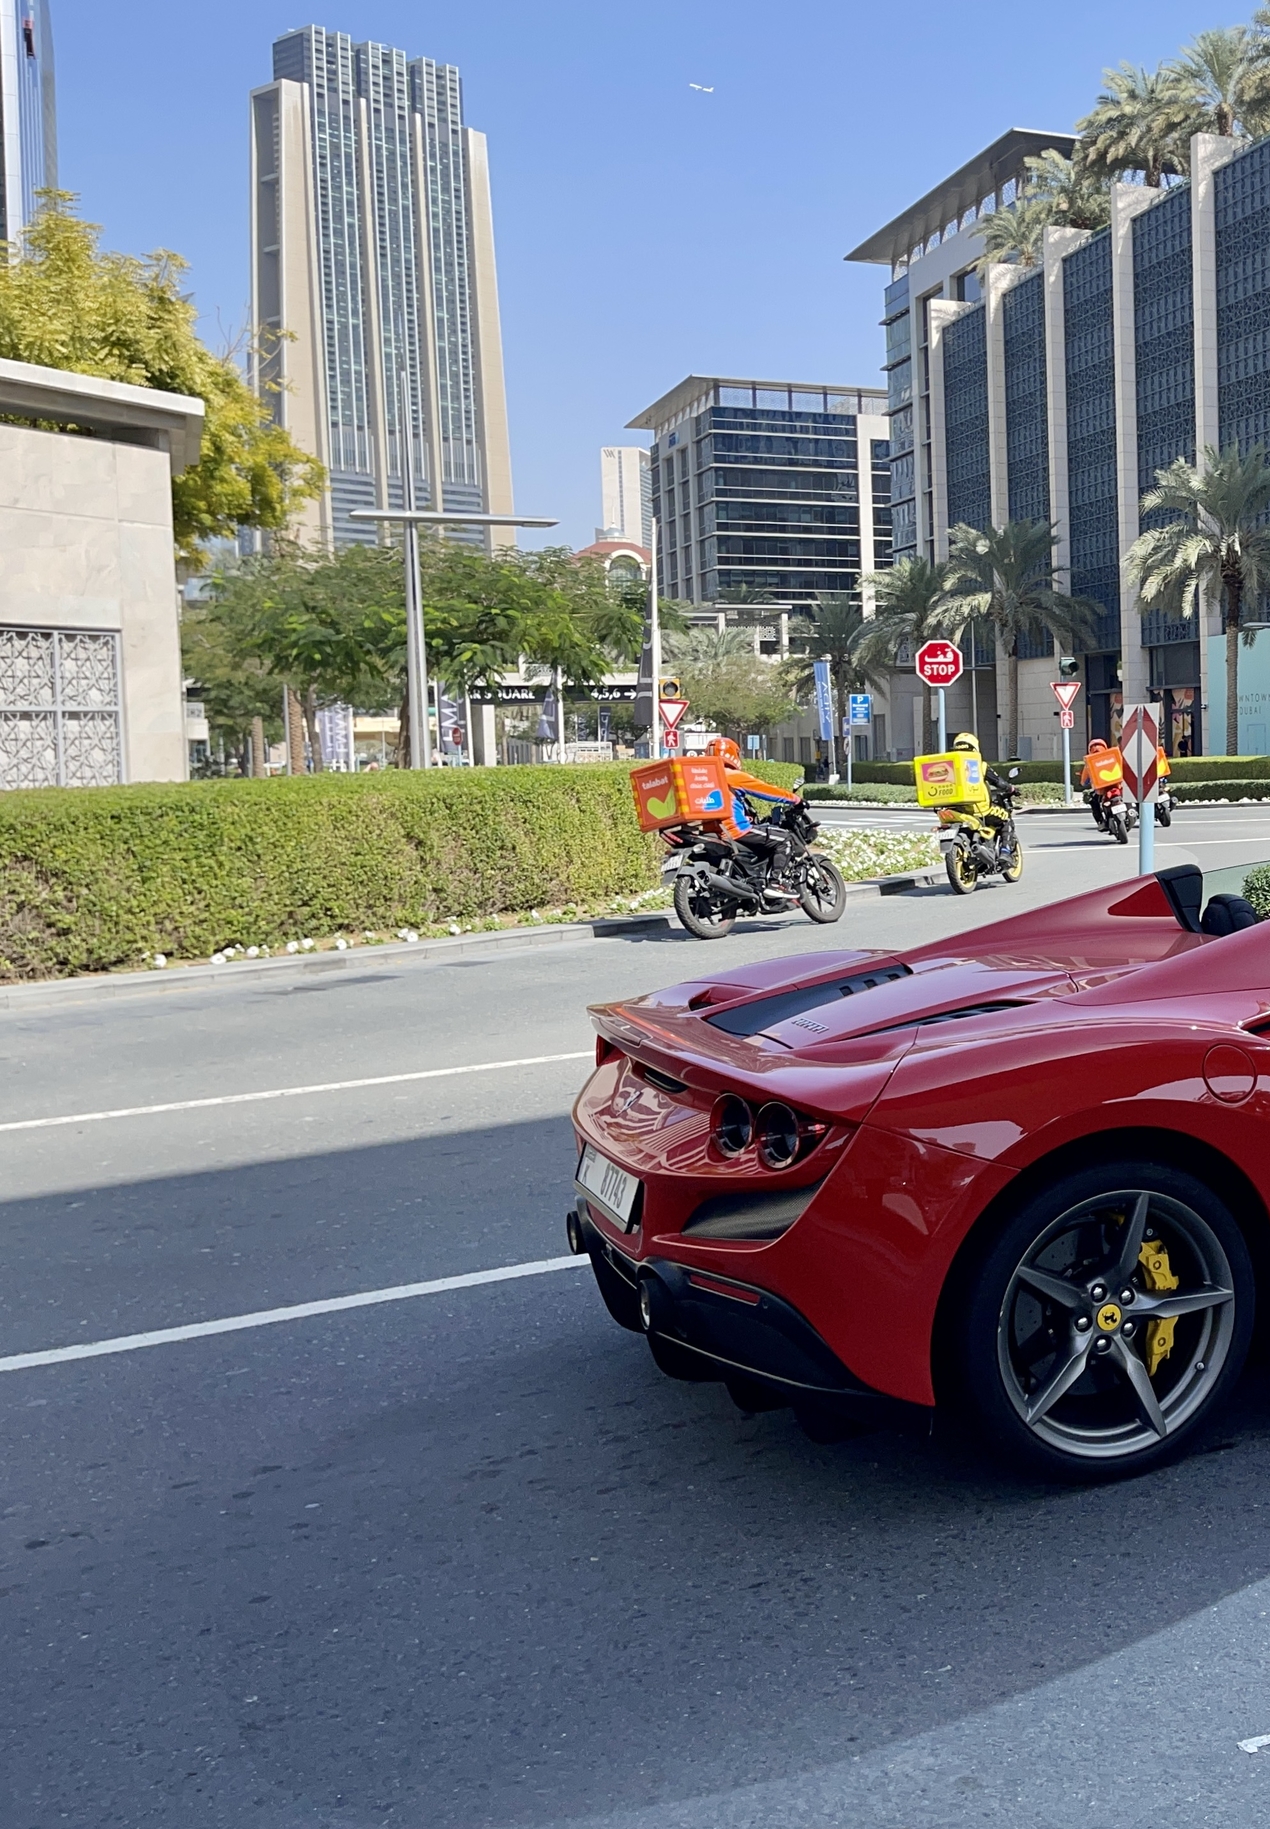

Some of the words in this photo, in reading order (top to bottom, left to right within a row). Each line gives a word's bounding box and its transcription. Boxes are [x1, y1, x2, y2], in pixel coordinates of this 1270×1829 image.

[924, 647, 954, 662] قف
[924, 664, 955, 675] STOP
[1239, 705, 1262, 715] DUBAI
[641, 775, 669, 790] talabat
[938, 788, 954, 796] FOOD
[600, 1162, 627, 1209] 87743
